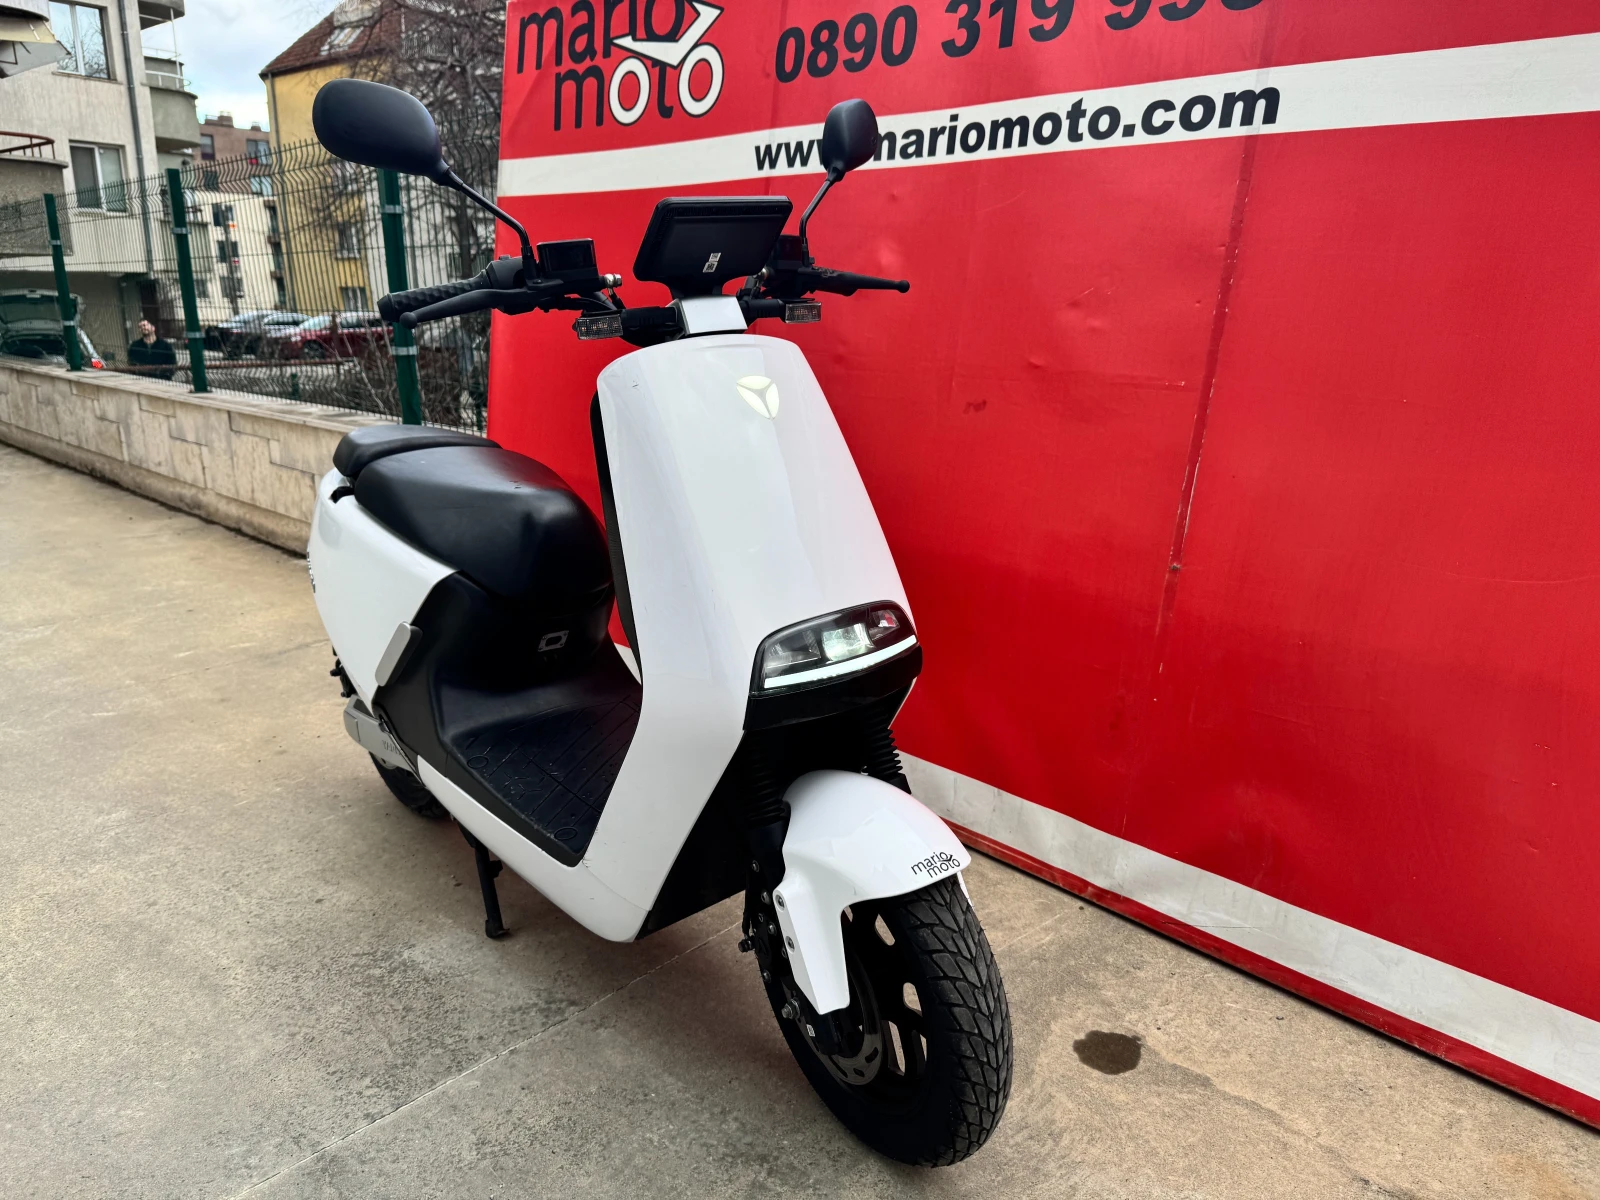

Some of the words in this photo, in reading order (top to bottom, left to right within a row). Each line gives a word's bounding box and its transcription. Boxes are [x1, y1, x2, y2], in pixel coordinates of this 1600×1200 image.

[517, 0, 686, 73] mario
[775, 2, 918, 83] 0890
[941, 0, 1074, 58] 319
[554, 42, 725, 131] moto
[754, 86, 1281, 171] wwmariomoto.com
[911, 852, 949, 875] mario
[926, 858, 961, 878] moto
